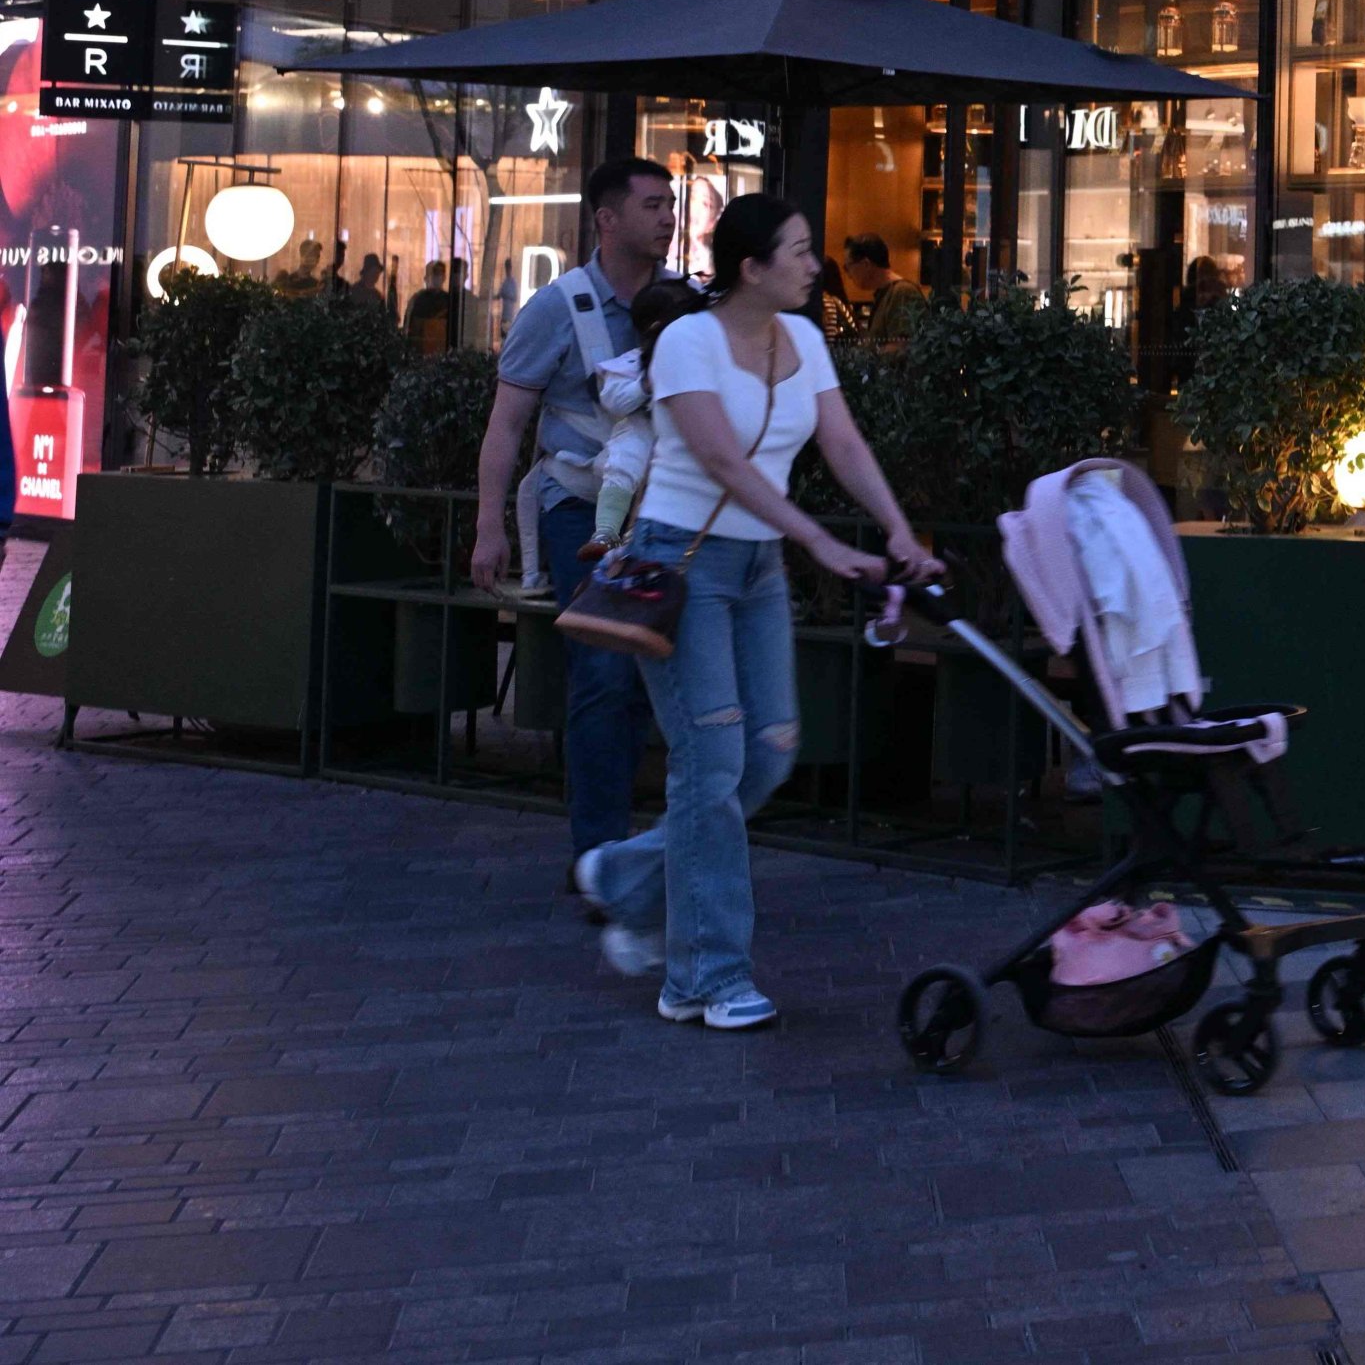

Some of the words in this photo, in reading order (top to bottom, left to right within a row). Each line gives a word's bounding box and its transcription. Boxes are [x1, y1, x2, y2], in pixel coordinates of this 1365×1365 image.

[84, 47, 108, 75] R
[55, 96, 80, 108] BAR
[84, 98, 132, 111] MIXATO
[20, 476, 63, 500] CHANEL
